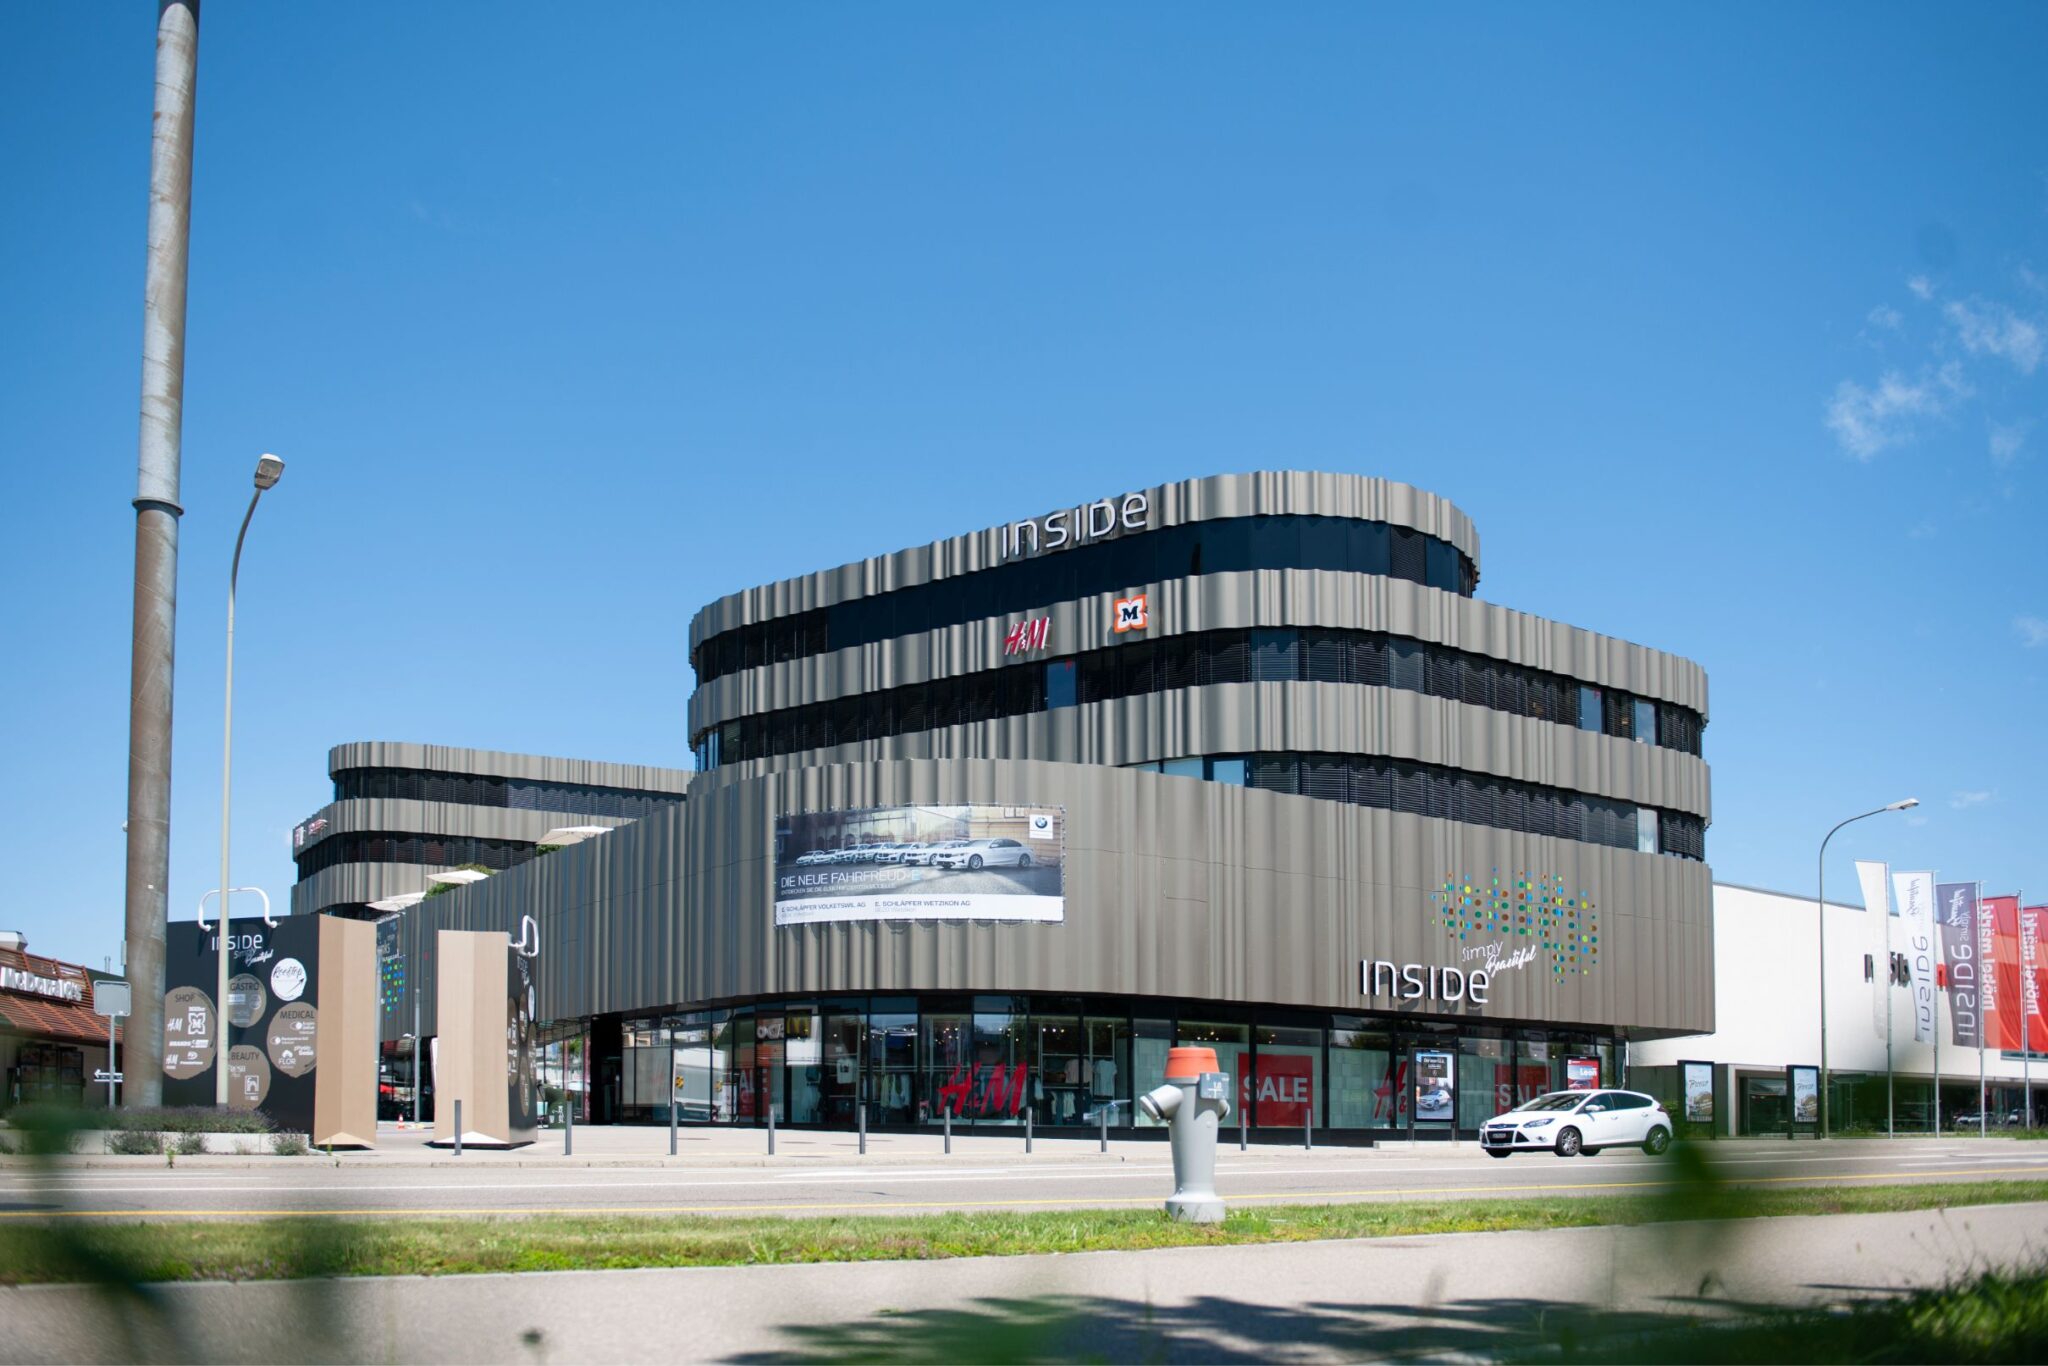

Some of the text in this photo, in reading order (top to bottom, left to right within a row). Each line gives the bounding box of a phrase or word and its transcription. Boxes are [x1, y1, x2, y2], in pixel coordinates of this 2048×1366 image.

[1121, 605, 1139, 622] M
[1004, 616, 1050, 656] H&M
[781, 876, 796, 888] DIE
[798, 873, 828, 886] NEUE
[211, 934, 263, 951] ISIDE
[230, 983, 260, 991] GASTRO
[280, 1010, 315, 1019] MEDICAL
[231, 1052, 260, 1061] BEAUTY
[1243, 1075, 1308, 1103] SALE
